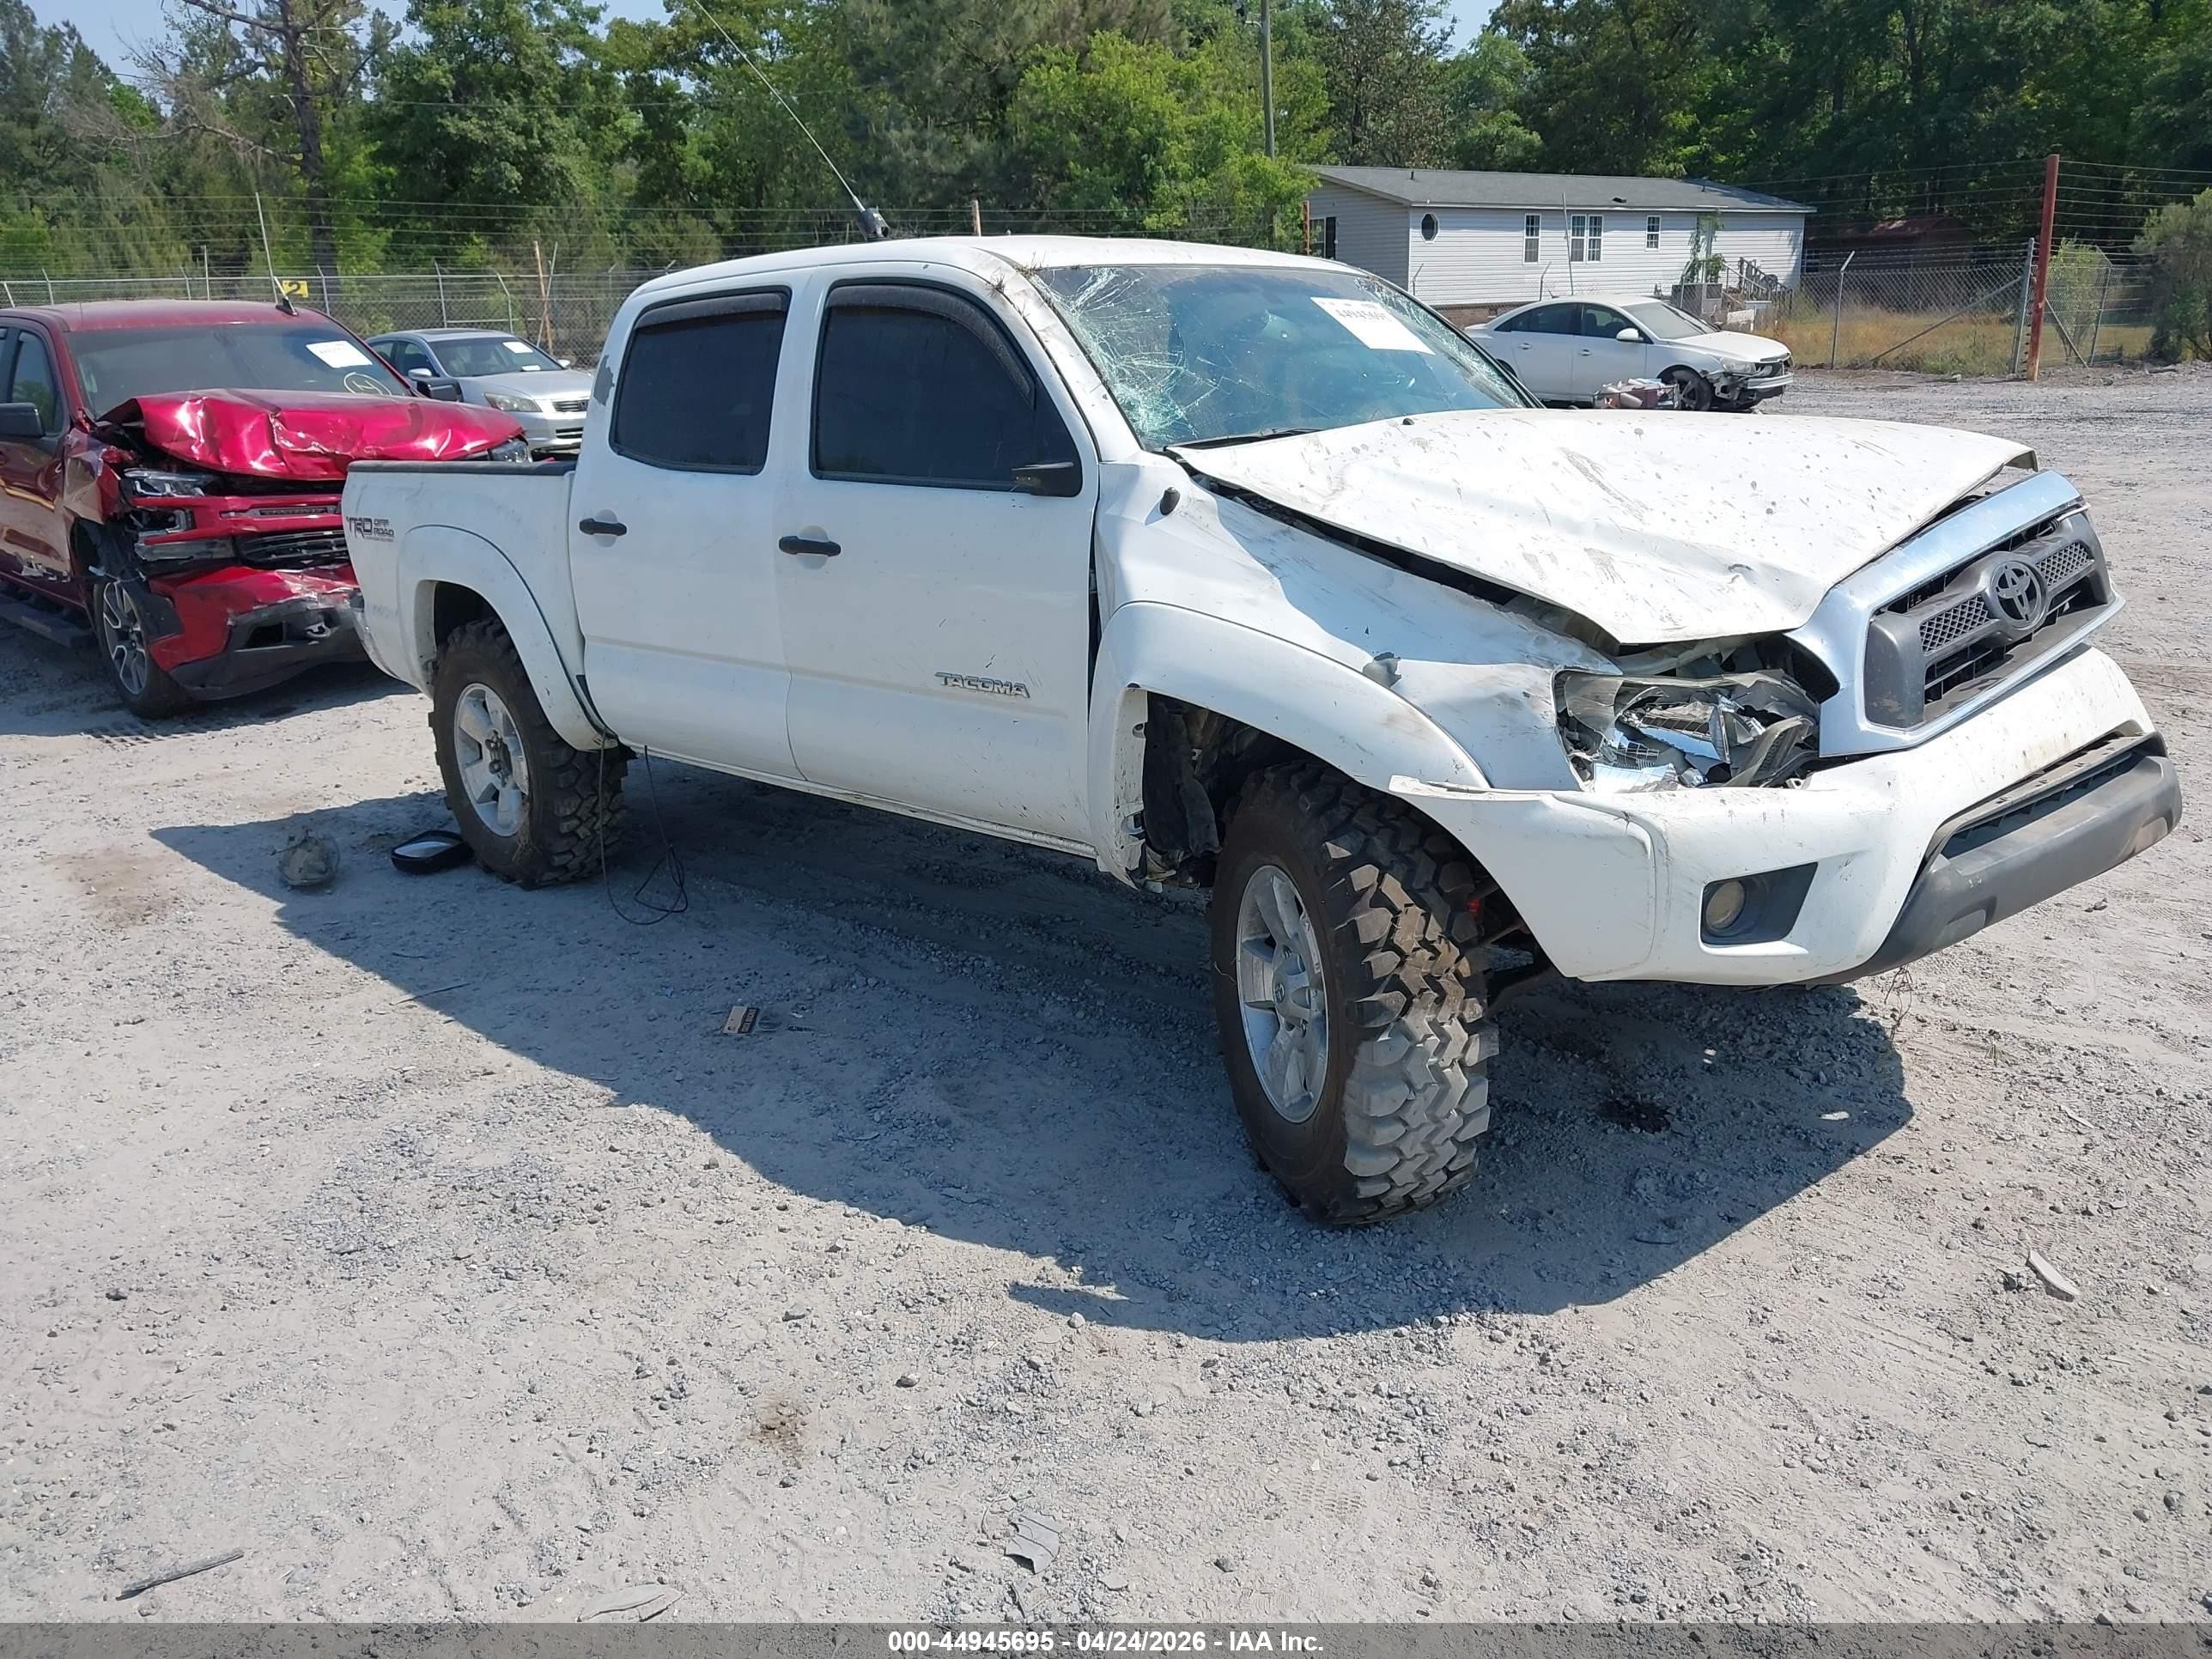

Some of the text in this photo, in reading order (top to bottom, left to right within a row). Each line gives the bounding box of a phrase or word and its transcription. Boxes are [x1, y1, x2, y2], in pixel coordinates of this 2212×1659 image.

[286, 281, 303, 296] 2
[345, 516, 373, 538] TRD
[374, 527, 395, 537] ROAD
[934, 672, 1030, 698] TACOMA
